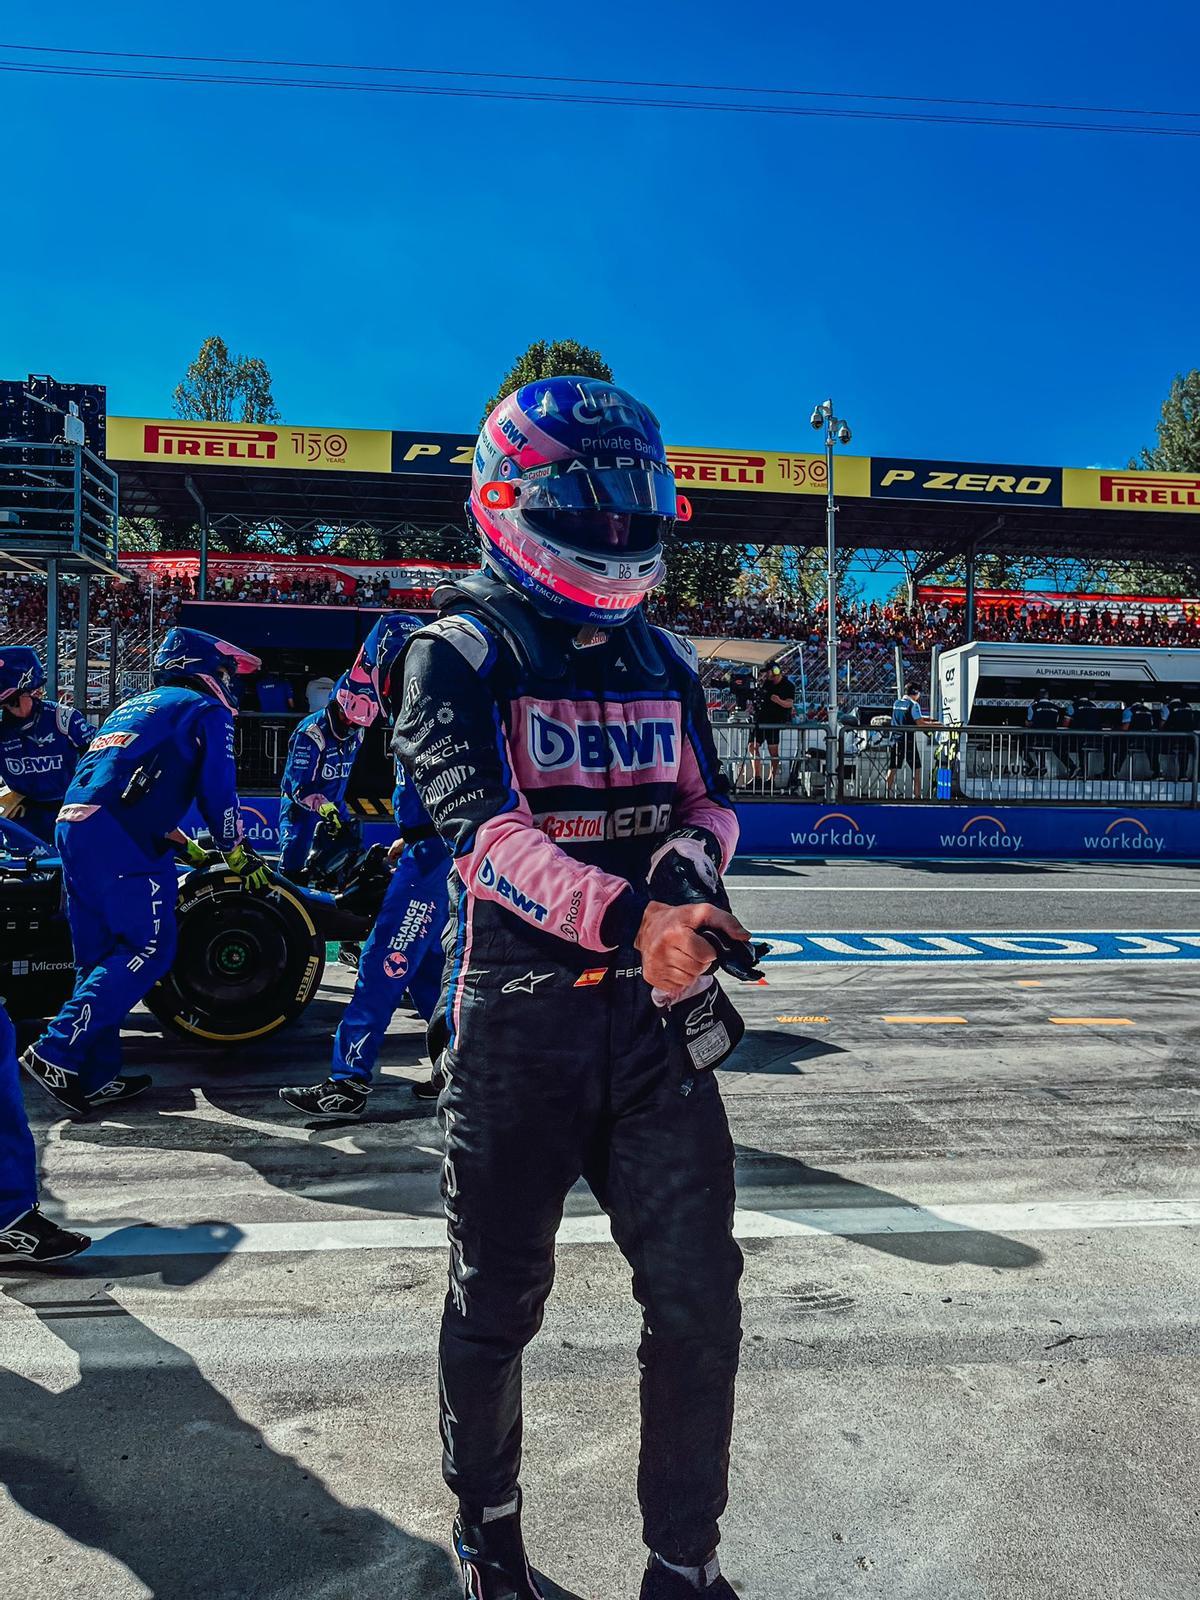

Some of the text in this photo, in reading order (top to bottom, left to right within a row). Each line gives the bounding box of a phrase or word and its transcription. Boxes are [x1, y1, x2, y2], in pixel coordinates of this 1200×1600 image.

[144, 425, 278, 459] PIRELLI
[291, 433, 347, 461] 150
[501, 419, 529, 451] BWT
[581, 437, 631, 451] Private
[403, 444, 441, 461] P
[528, 470, 551, 480] Castrol
[778, 459, 828, 486] 150
[880, 469, 1051, 494] P ZERO
[1100, 476, 1200, 505] PIRELL
[589, 611, 613, 620] Private
[415, 735, 453, 764] RENAULT
[576, 719, 676, 770] BWT
[22, 755, 63, 774] BWT
[415, 741, 470, 780] E-TECH
[427, 765, 468, 805] DUPONT
[541, 815, 602, 839] Castrol
[790, 831, 876, 851] workday
[940, 832, 1022, 852] workday
[1084, 833, 1164, 853] workday
[496, 875, 549, 925] BWT
[565, 890, 583, 924] ROSS
[393, 899, 420, 950] CHANGE
[405, 902, 428, 943] WORLD
[31, 961, 76, 972] Microso
[615, 966, 643, 979] FER
